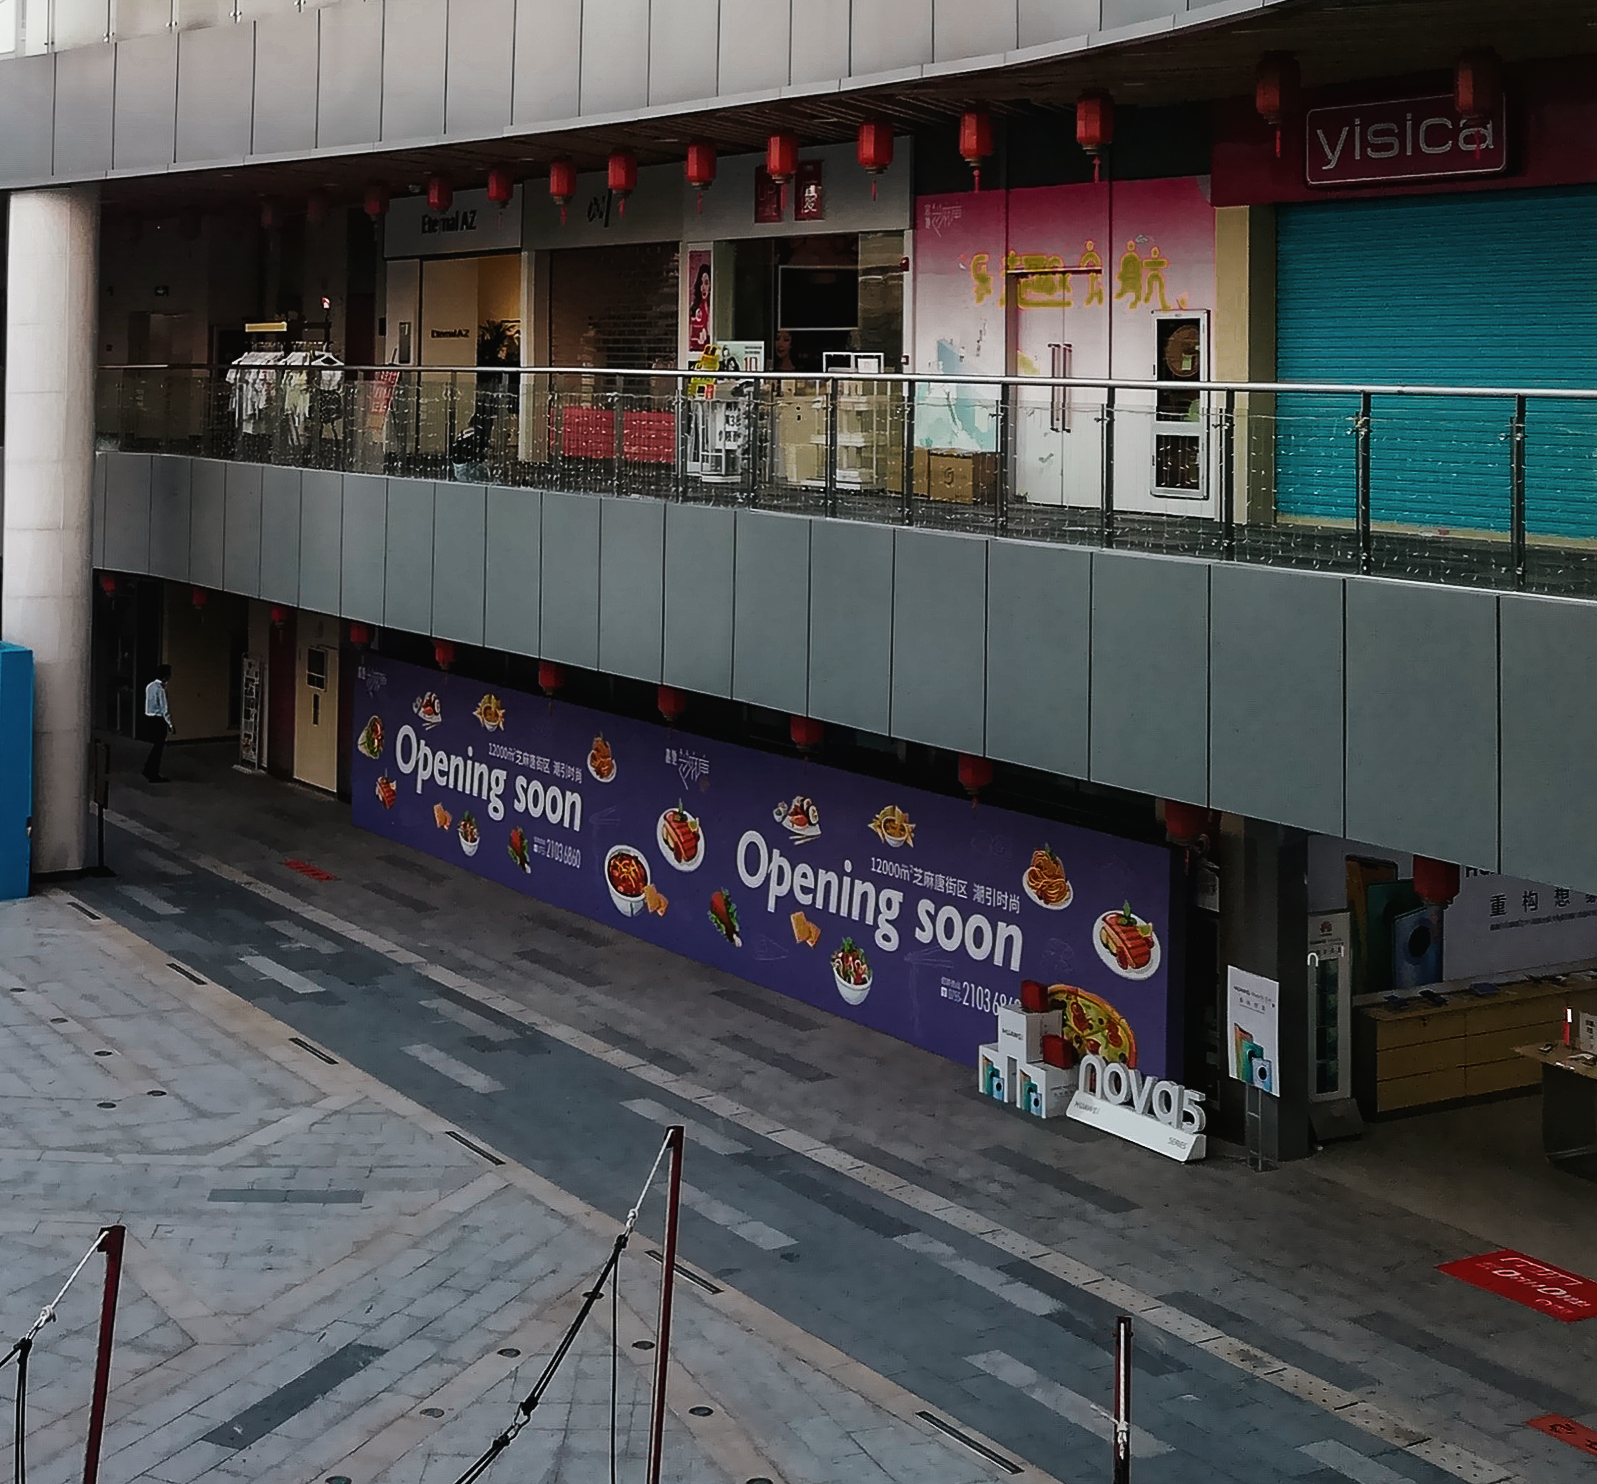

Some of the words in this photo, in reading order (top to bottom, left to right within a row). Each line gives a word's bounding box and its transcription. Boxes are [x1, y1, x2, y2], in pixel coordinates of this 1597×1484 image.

[1316, 112, 1495, 170] yisica
[422, 210, 459, 234] Eternal
[460, 209, 477, 230] AZ
[395, 724, 507, 821] Opening
[514, 775, 582, 832] soon
[736, 830, 904, 952] Opening
[914, 898, 1023, 972] soon
[972, 882, 1020, 915] 潮引时尚
